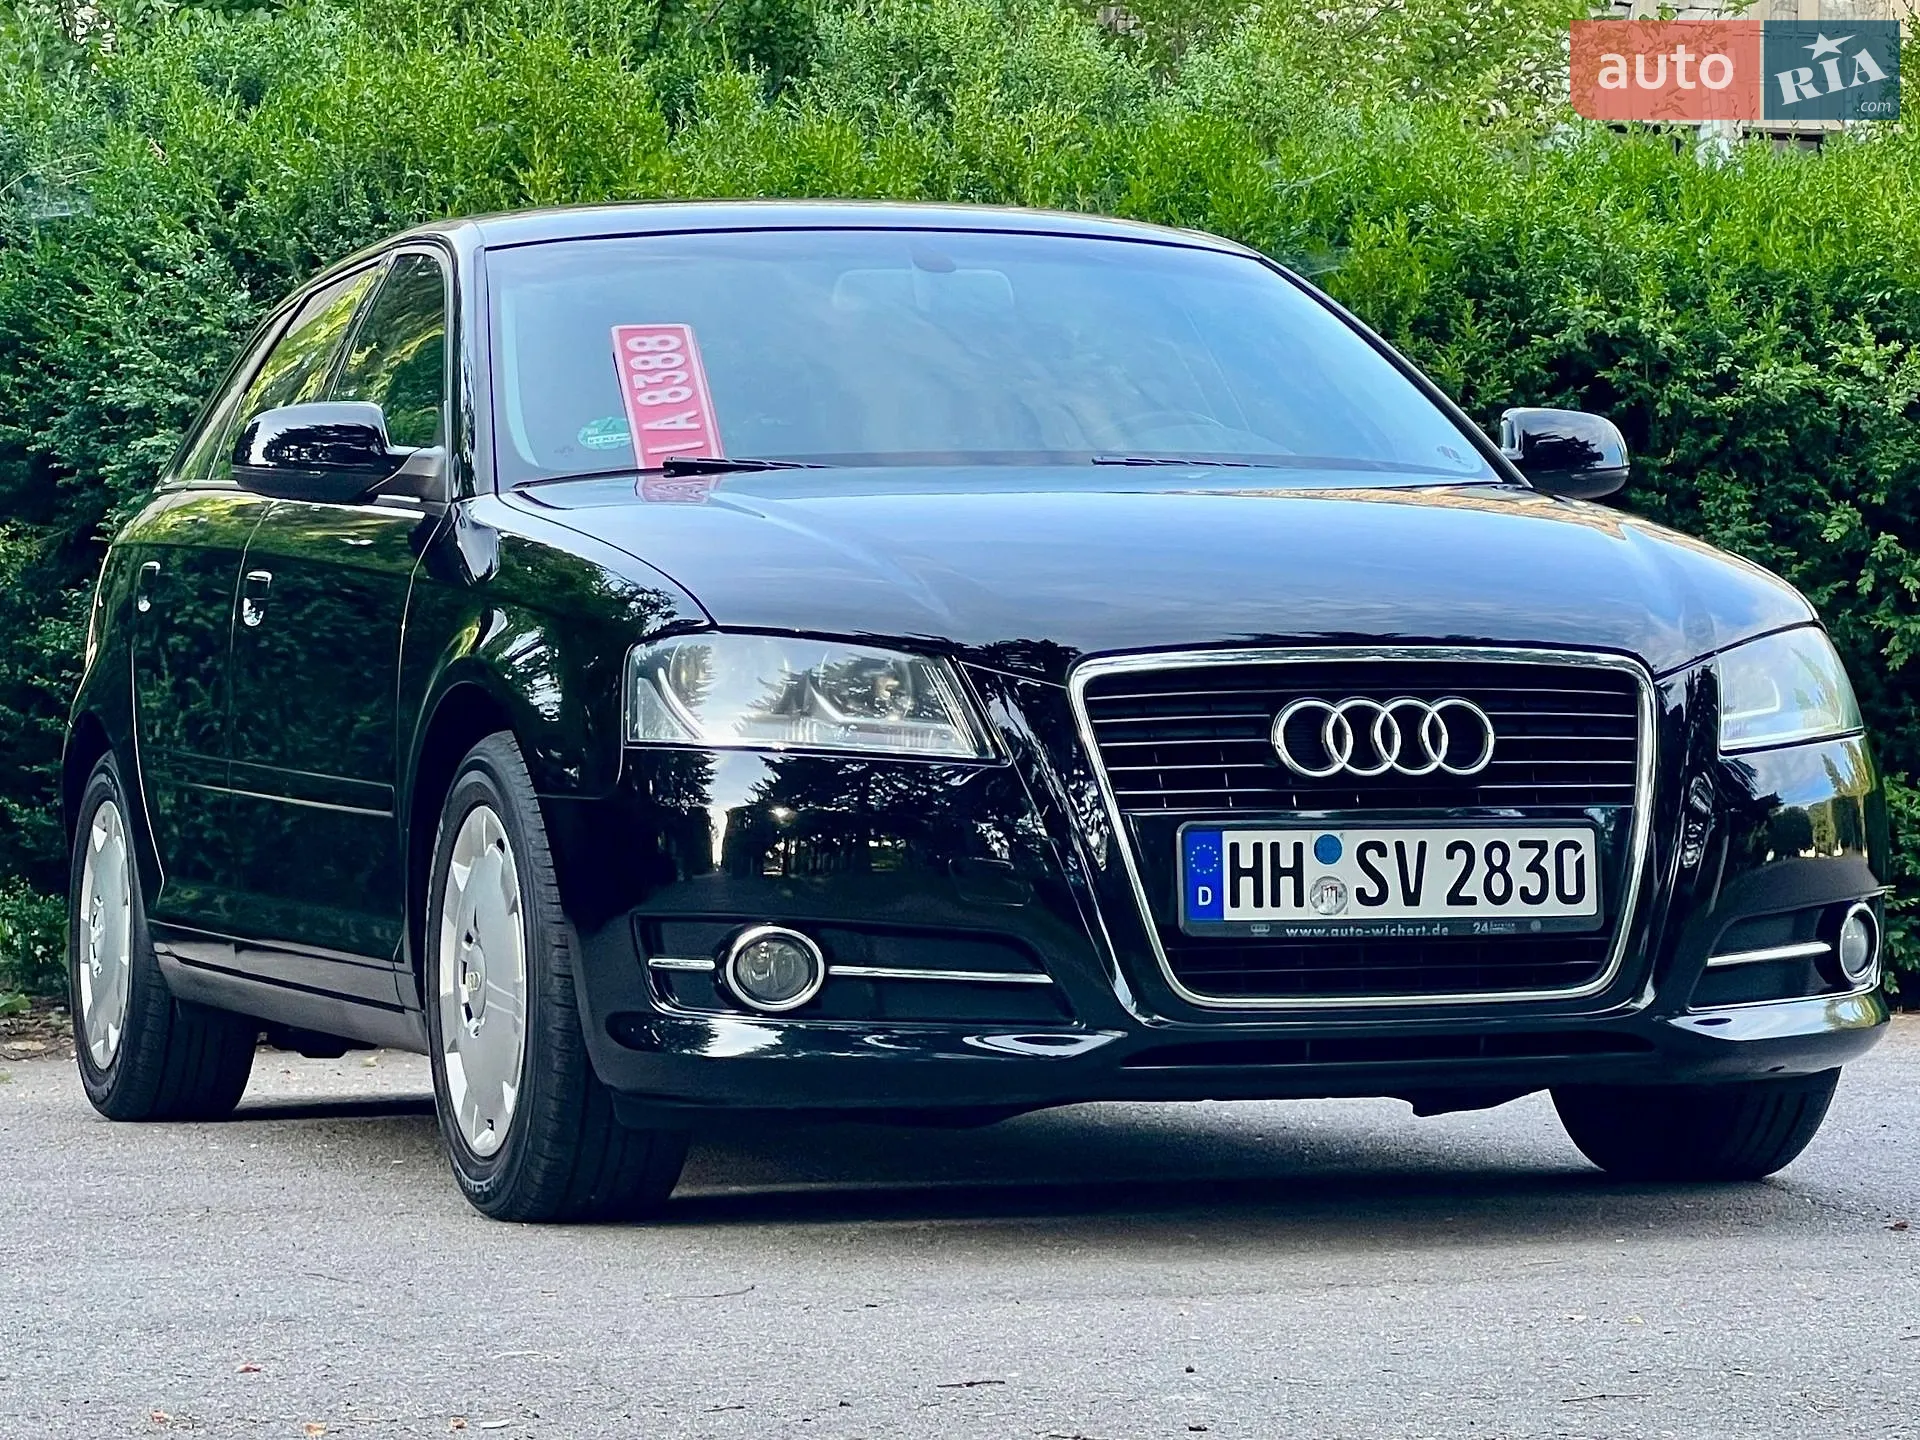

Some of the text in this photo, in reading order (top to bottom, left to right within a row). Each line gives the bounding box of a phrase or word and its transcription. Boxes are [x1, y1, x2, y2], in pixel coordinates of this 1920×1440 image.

[626, 334, 693, 406] 8388
[1198, 886, 1212, 906] D
[1229, 840, 1585, 909] HH SV 2830
[1286, 922, 1449, 937] www.auto-wichert.de
